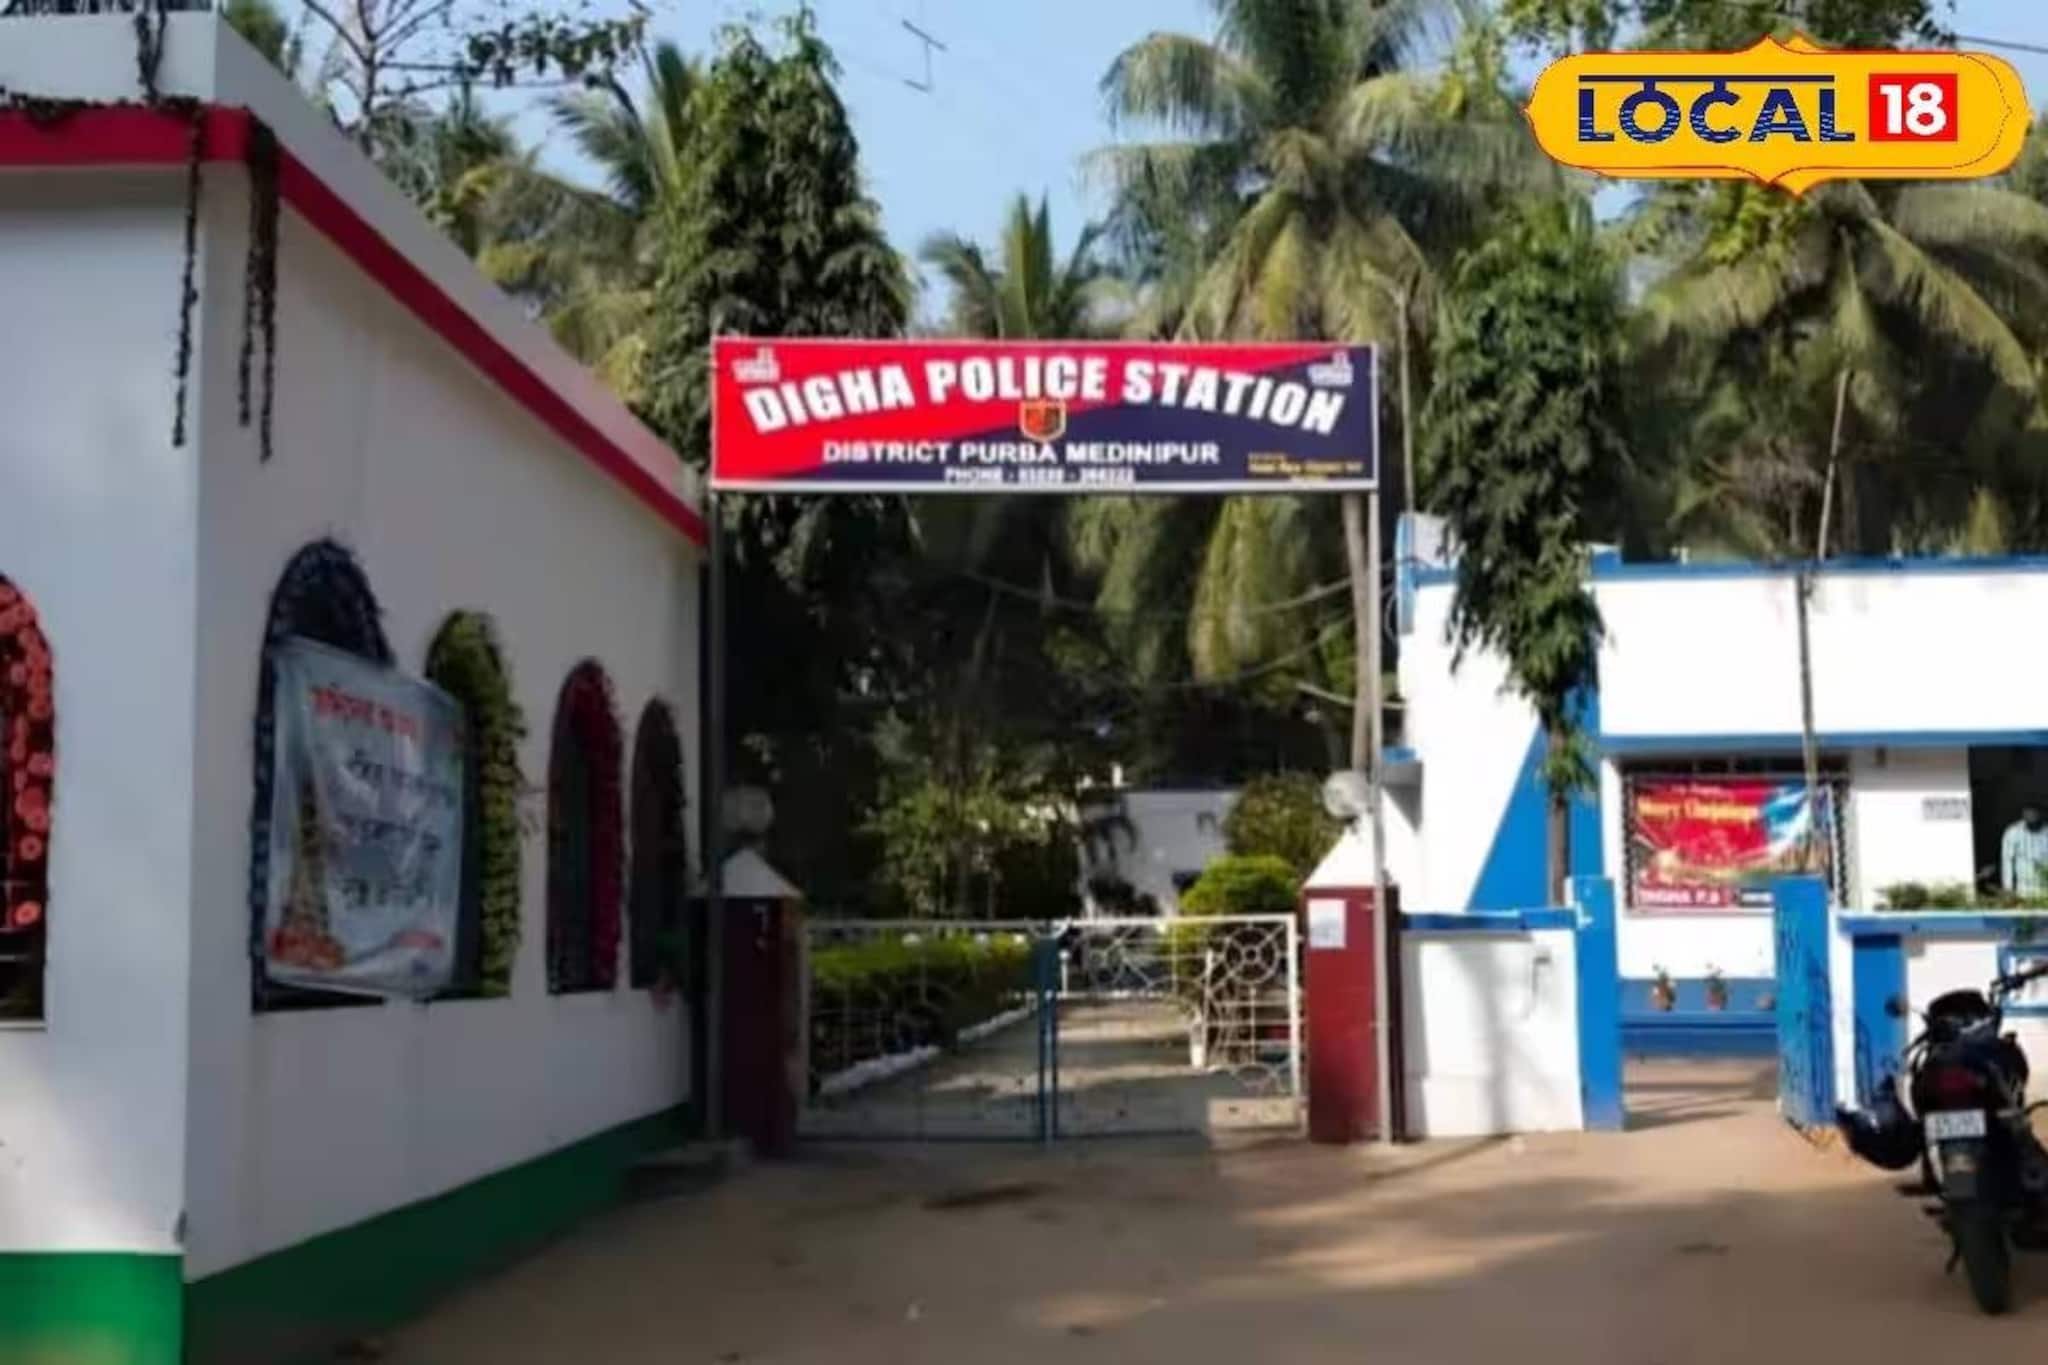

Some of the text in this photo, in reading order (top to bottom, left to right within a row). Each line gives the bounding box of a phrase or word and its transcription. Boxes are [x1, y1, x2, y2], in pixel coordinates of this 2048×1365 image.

[743, 364, 916, 434] DIGHA
[925, 355, 1108, 403] POLICE
[1122, 359, 1345, 436] STATION
[822, 440, 951, 464] DISTRICT
[959, 441, 1058, 464] PURBA
[1065, 441, 1220, 464] MEDINIPUR
